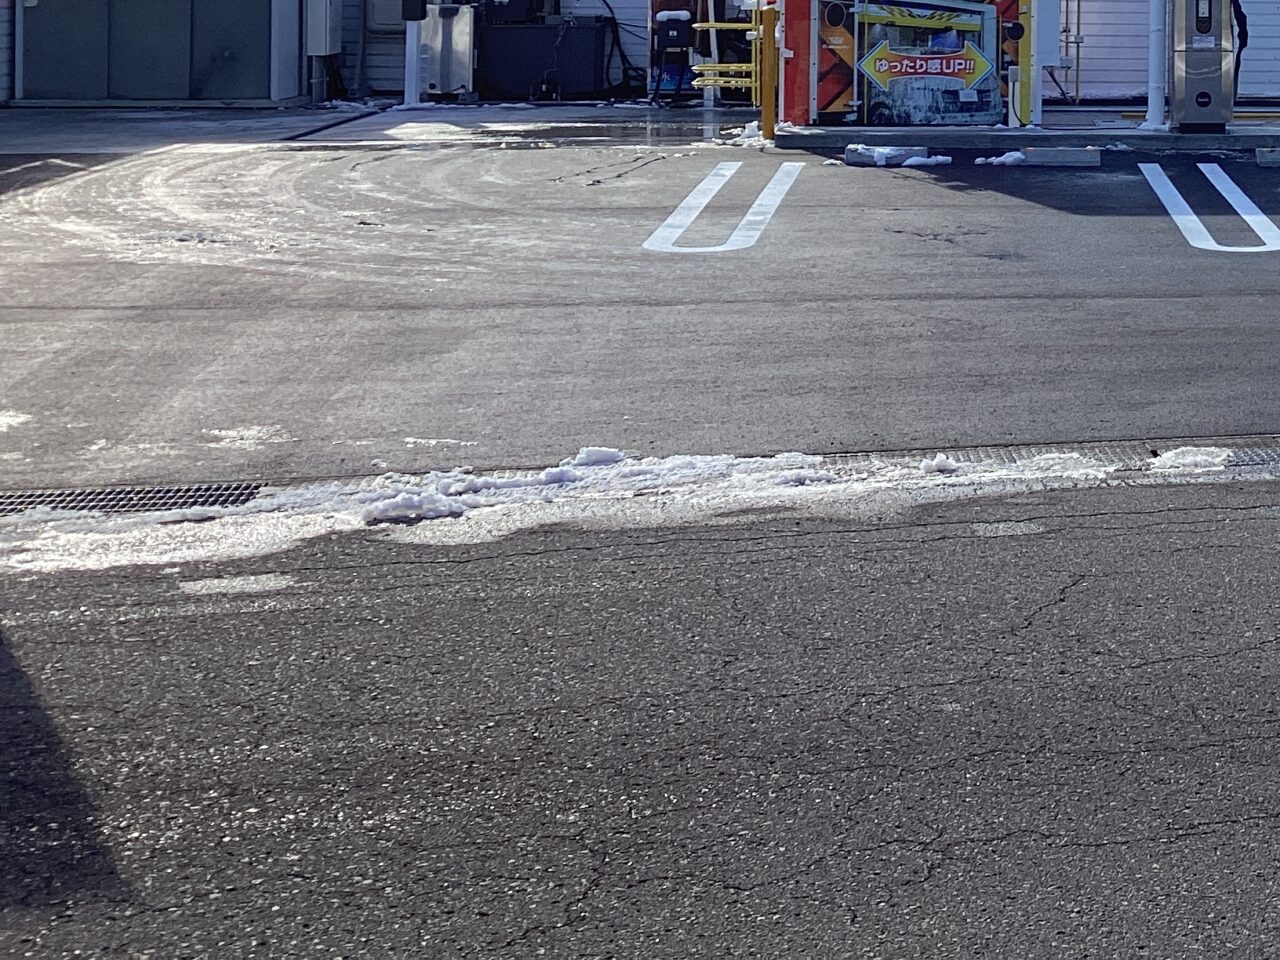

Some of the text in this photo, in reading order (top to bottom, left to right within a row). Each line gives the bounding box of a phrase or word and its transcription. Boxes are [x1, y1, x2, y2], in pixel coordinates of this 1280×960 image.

[875, 57, 975, 74] ゆったり感UP!!
